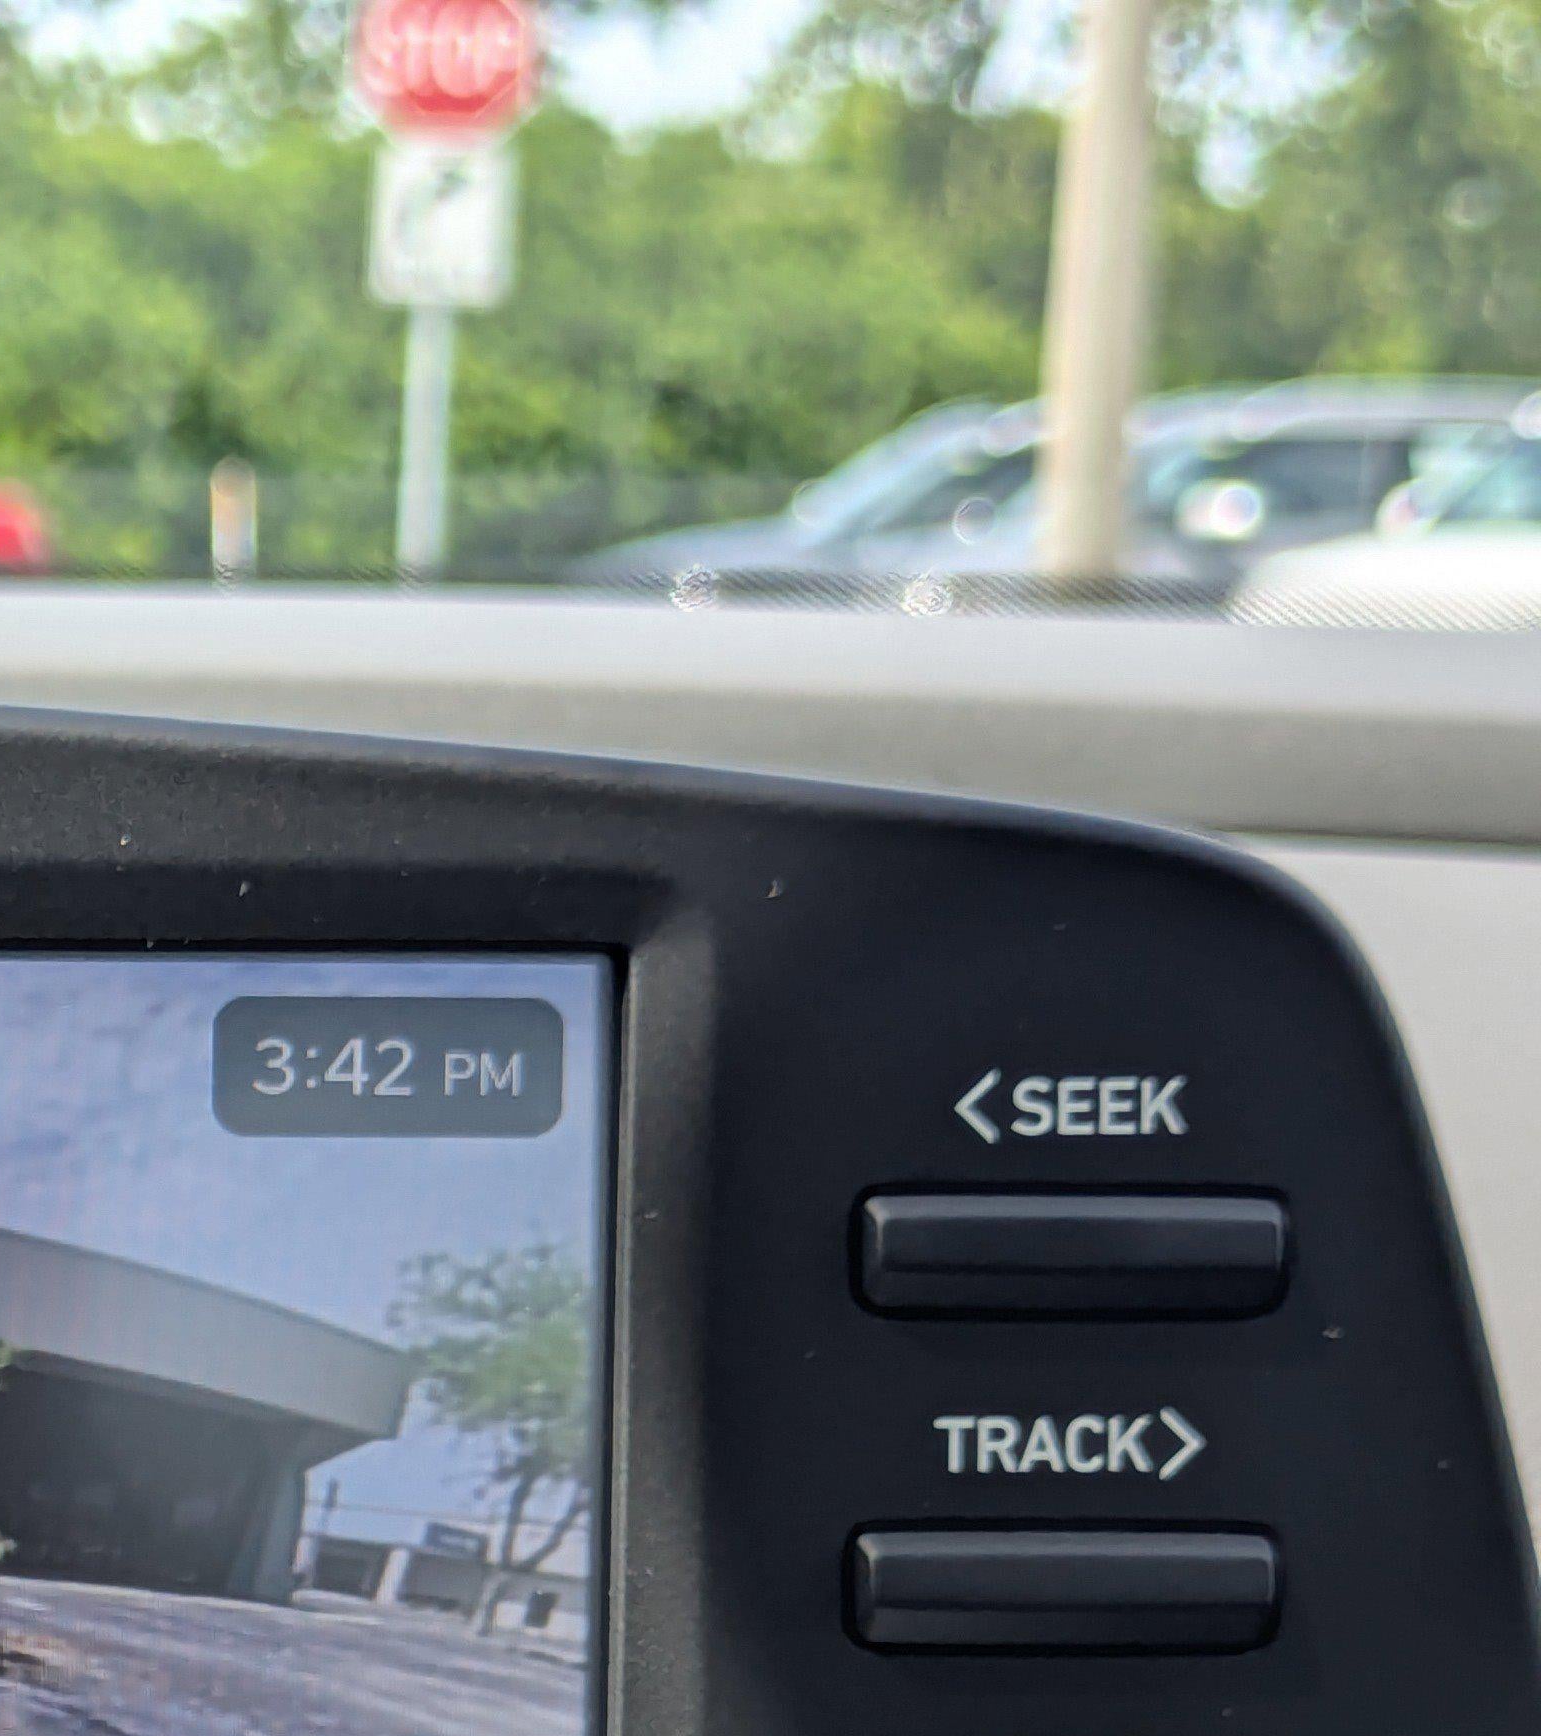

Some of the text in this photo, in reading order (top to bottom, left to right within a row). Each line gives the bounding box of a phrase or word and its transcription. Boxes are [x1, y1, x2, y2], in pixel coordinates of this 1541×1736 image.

[363, 0, 519, 97] STOP
[252, 1037, 523, 1097] 3:42 PM
[1009, 1075, 1186, 1137] SEEK
[932, 1414, 1152, 1475] TRACK
